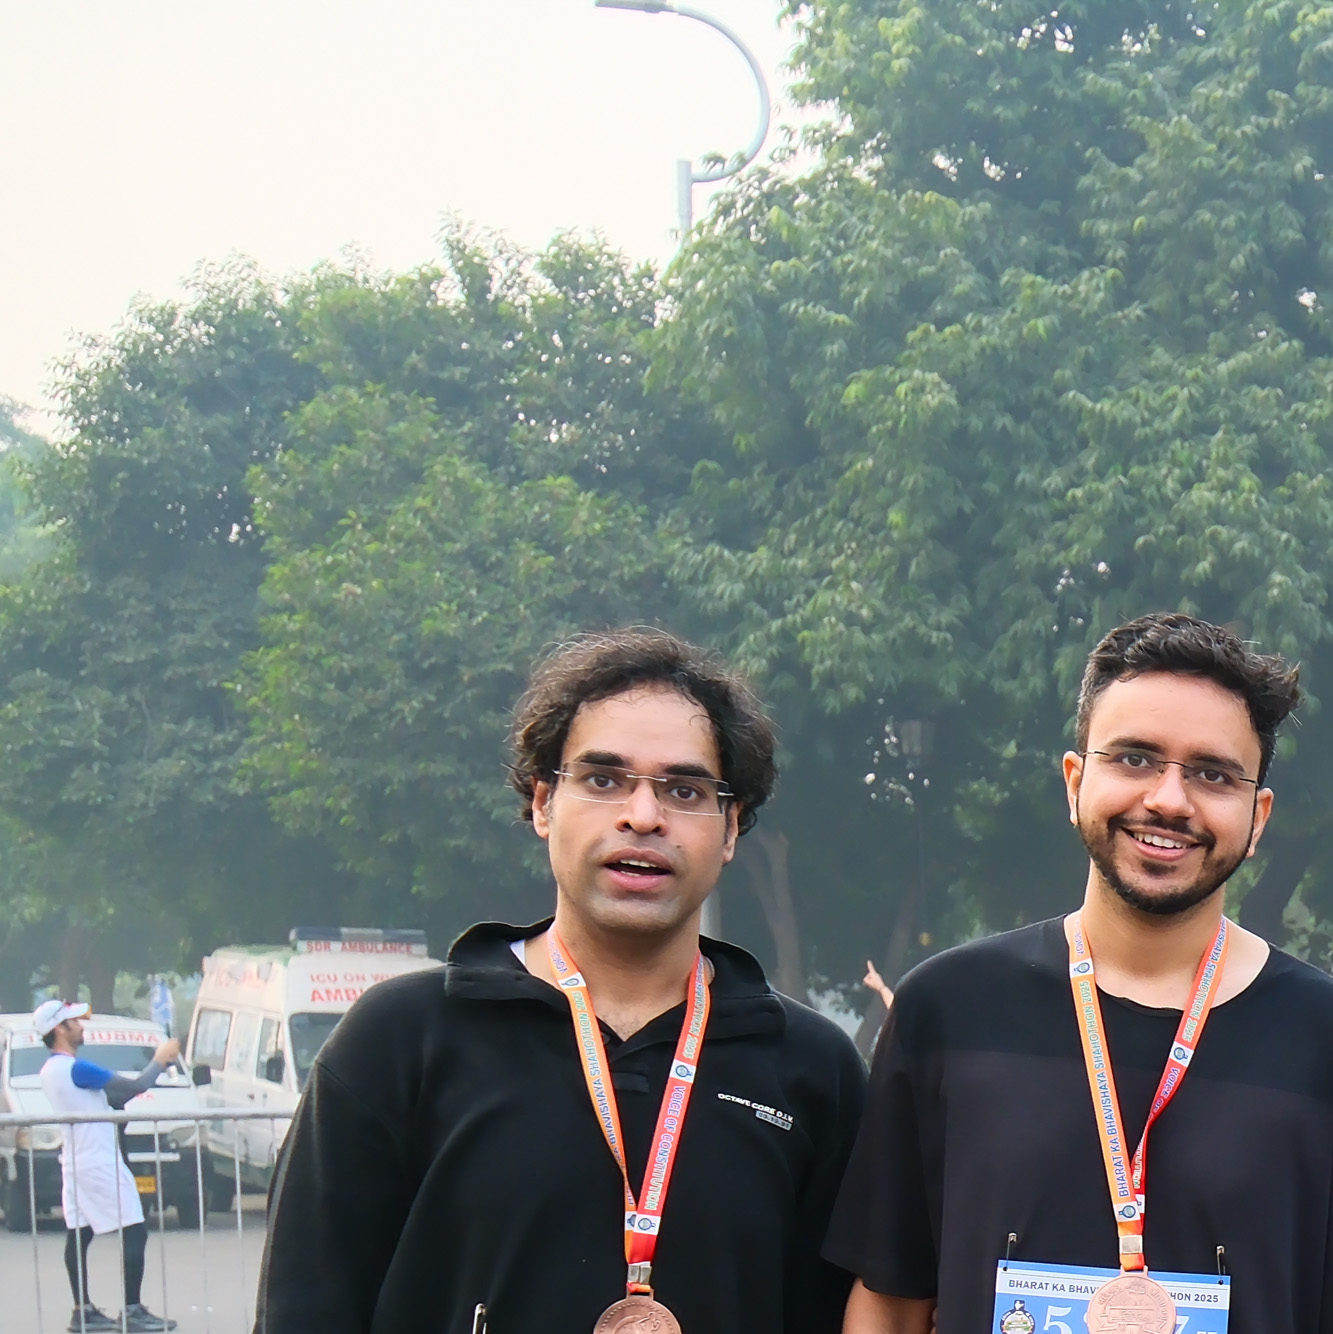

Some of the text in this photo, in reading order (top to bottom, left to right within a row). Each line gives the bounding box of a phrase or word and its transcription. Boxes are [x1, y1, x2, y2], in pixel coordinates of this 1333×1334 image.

[751, 1102, 777, 1115] CORE
[1079, 981, 1131, 1198] BHARAT KA BHAVISHAYA SHAHOTHON 2025
[644, 1085, 687, 1211] VOICE OF CONSTITUTION
[1008, 1279, 1220, 1303] BHARAT KA 2025
